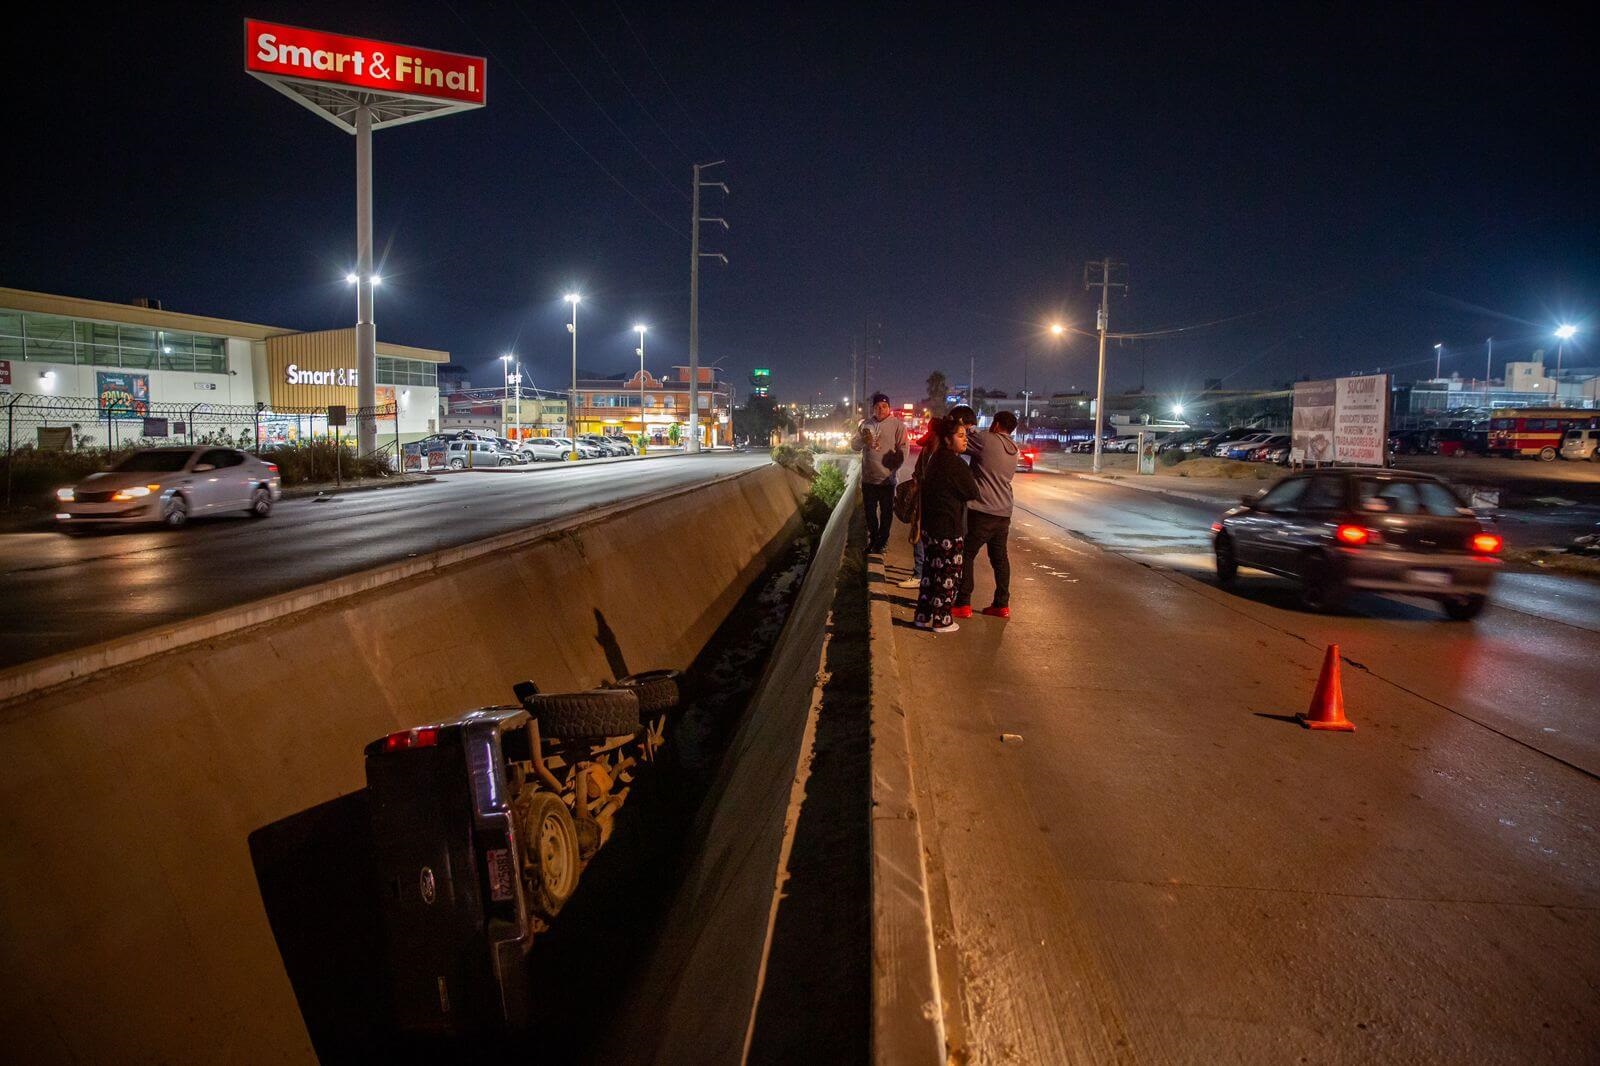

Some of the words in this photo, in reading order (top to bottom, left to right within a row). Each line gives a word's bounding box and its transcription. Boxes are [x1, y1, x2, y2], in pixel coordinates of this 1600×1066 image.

[257, 33, 364, 75] Smart
[369, 51, 390, 80] &
[287, 364, 335, 385] Smart
[337, 367, 346, 386] &
